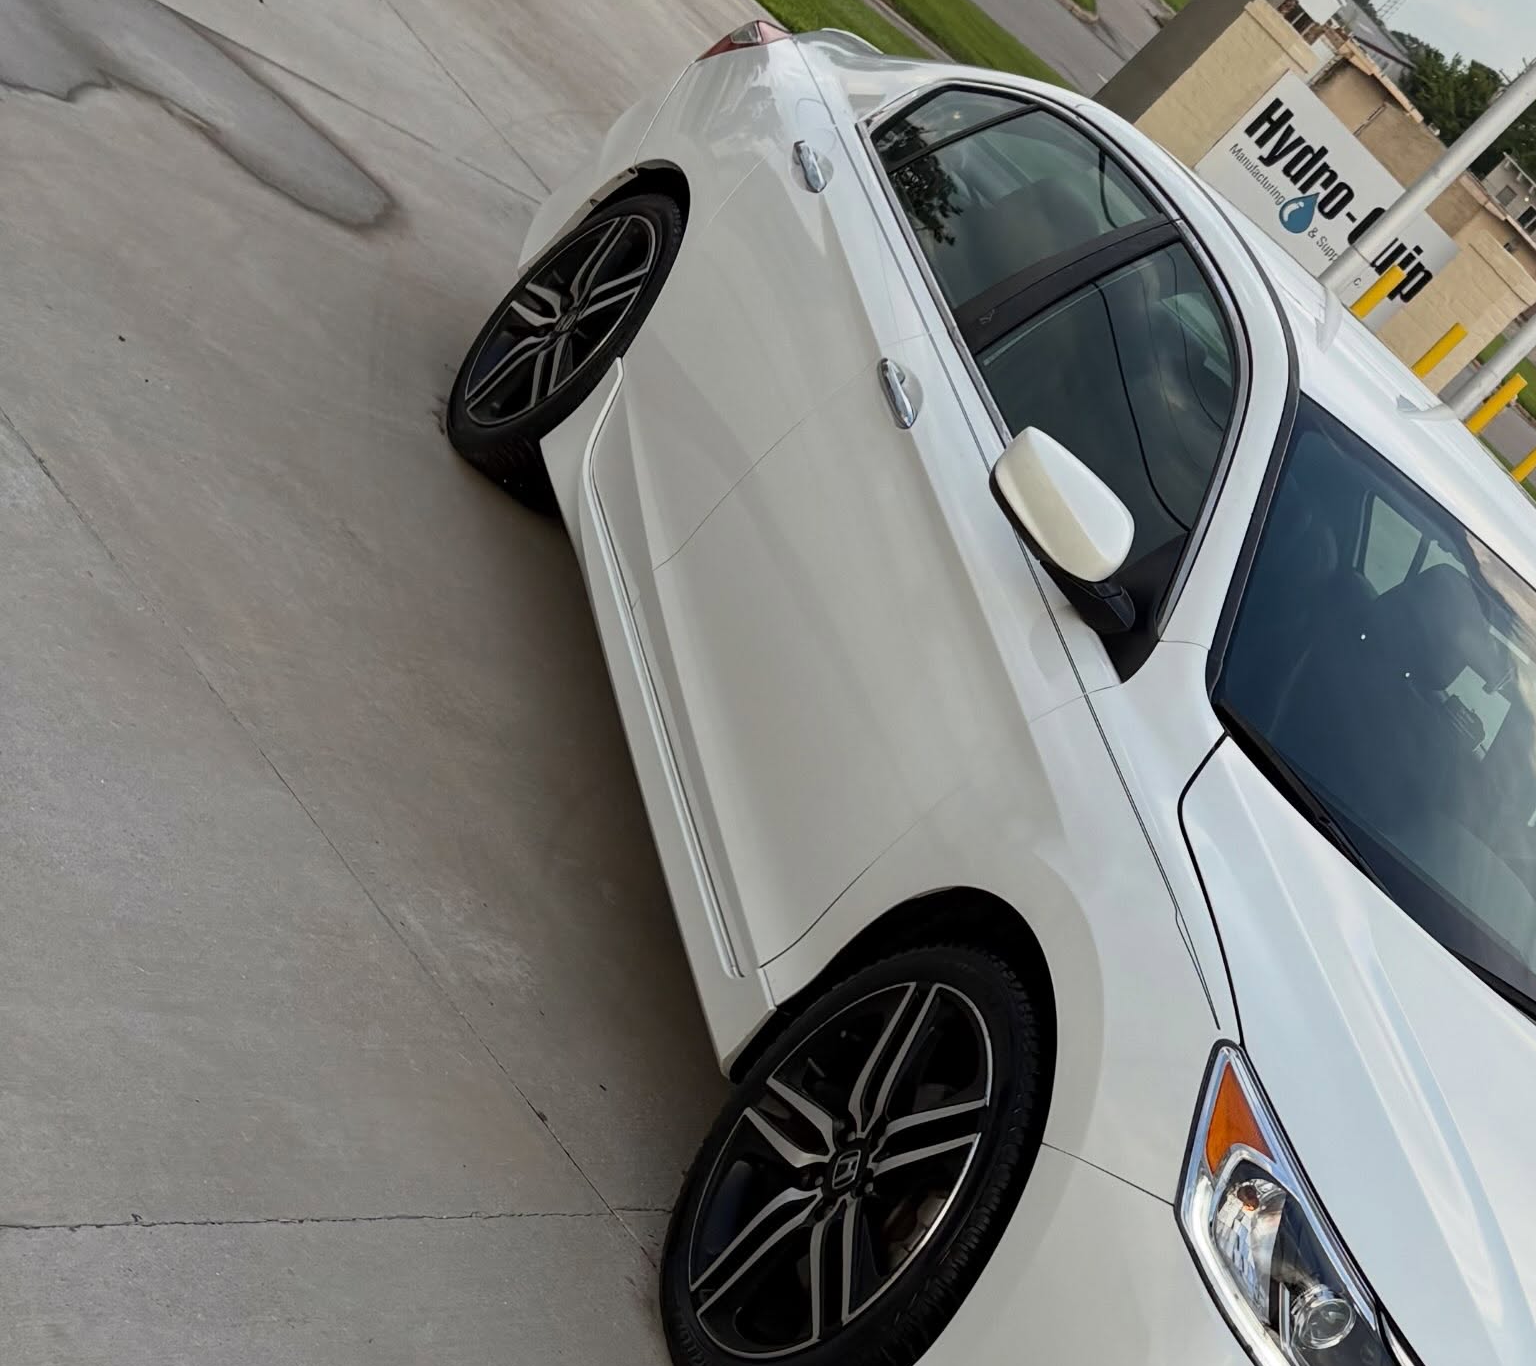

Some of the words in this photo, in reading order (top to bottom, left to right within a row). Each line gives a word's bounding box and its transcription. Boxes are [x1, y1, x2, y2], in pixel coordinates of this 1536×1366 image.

[1228, 142, 1286, 205] Manufacturing
[1306, 228, 1317, 239] &
[1315, 236, 1337, 263] Supp
